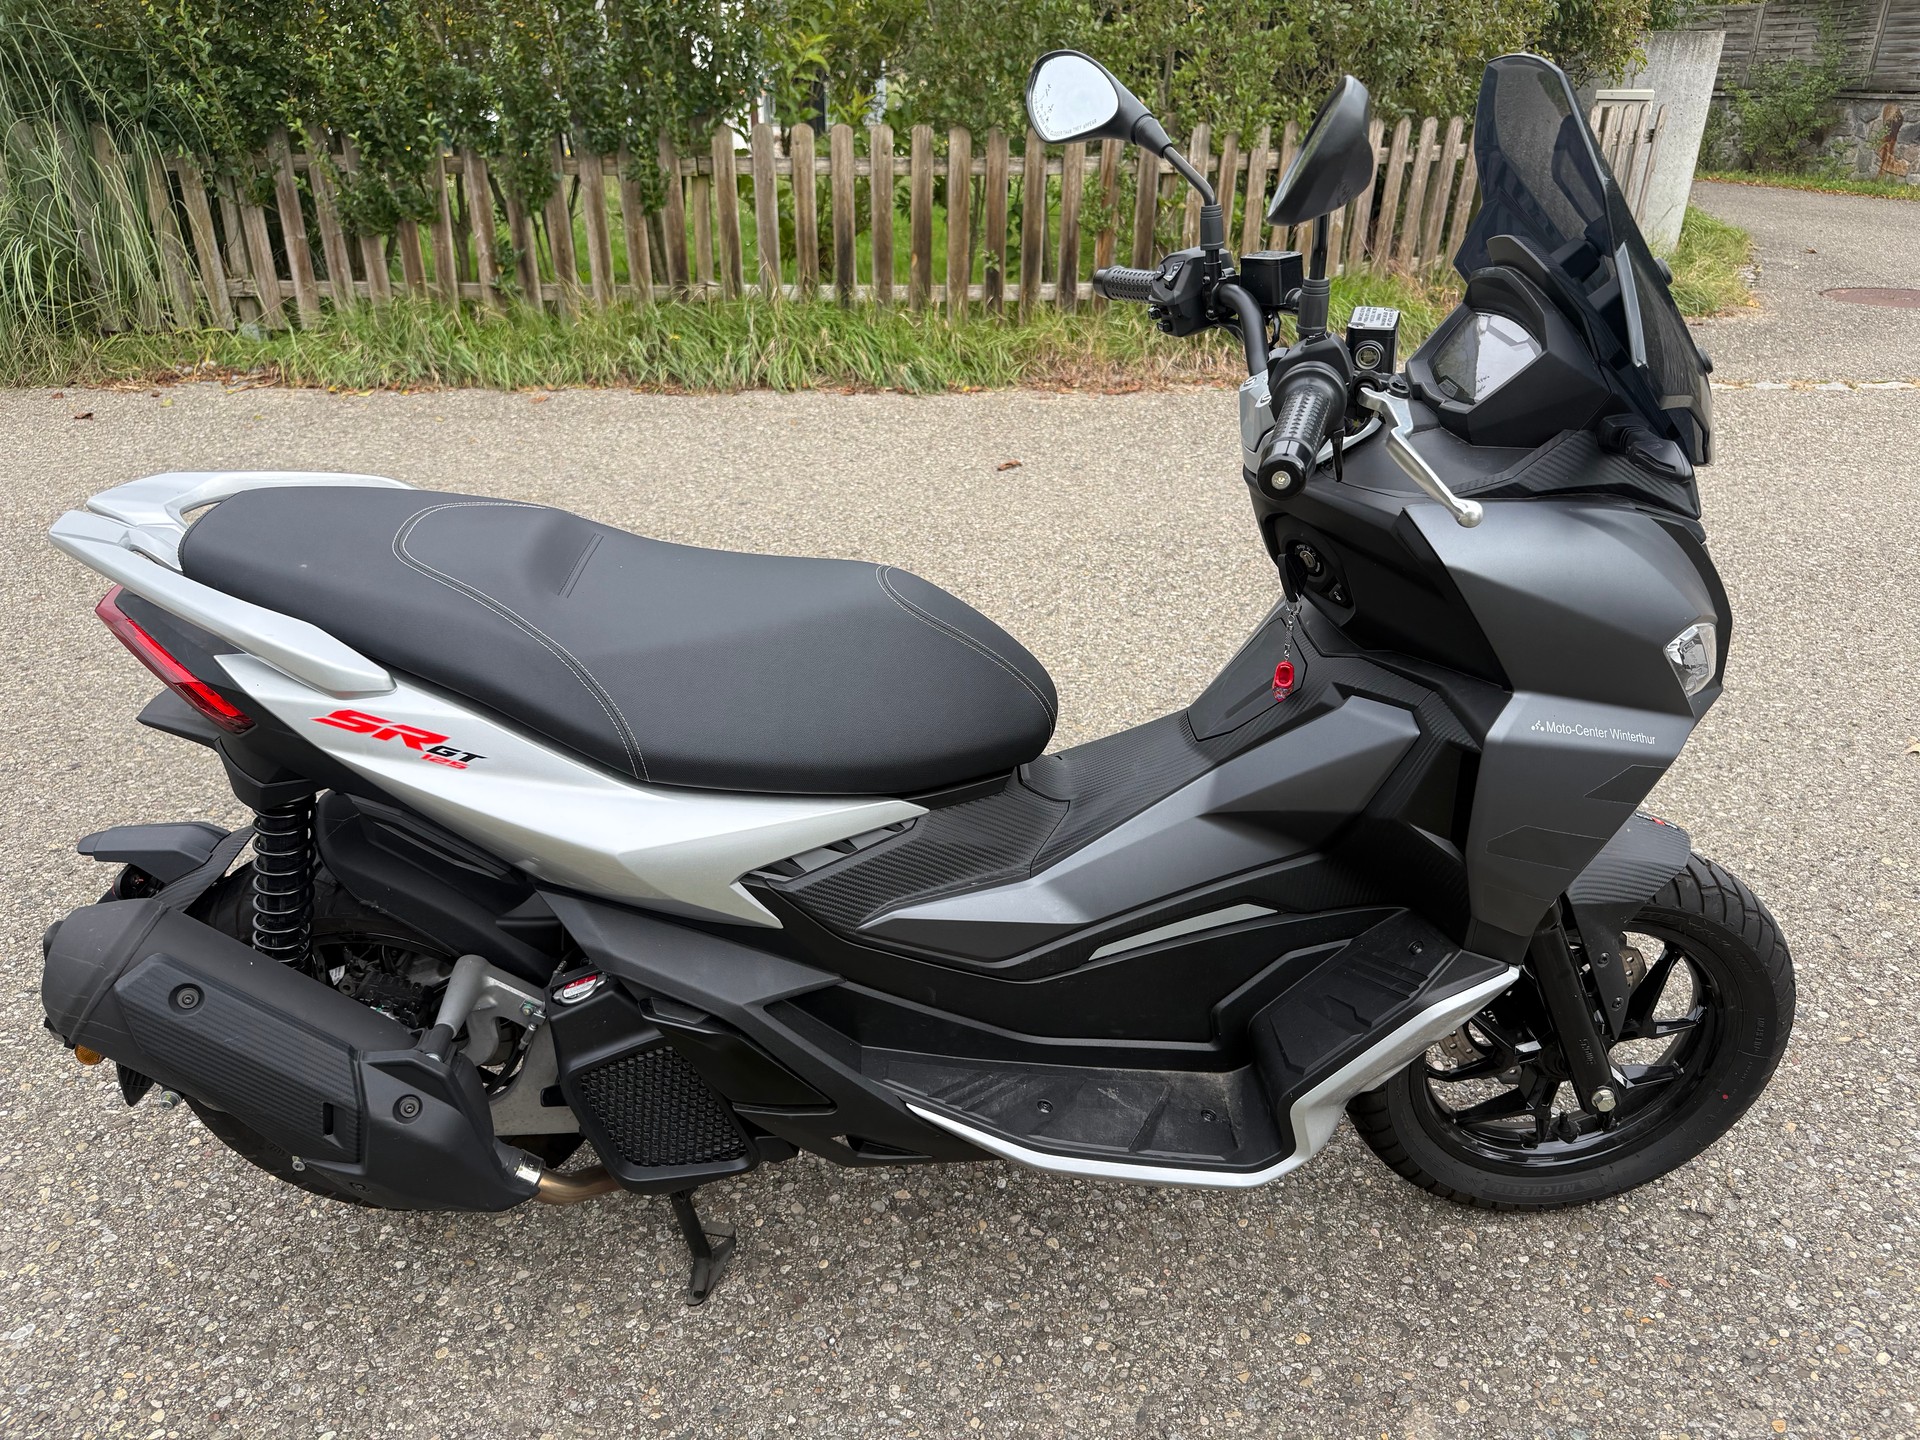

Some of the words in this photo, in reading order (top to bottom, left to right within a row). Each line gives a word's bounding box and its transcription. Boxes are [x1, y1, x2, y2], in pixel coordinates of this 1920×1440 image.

[309, 709, 451, 752] SR
[426, 745, 487, 763] GT
[1546, 721, 1608, 739] Moto-Center
[1609, 728, 1656, 745] Winterthur
[420, 754, 470, 770] 125
[1491, 1183, 1576, 1196] MICHELIN
